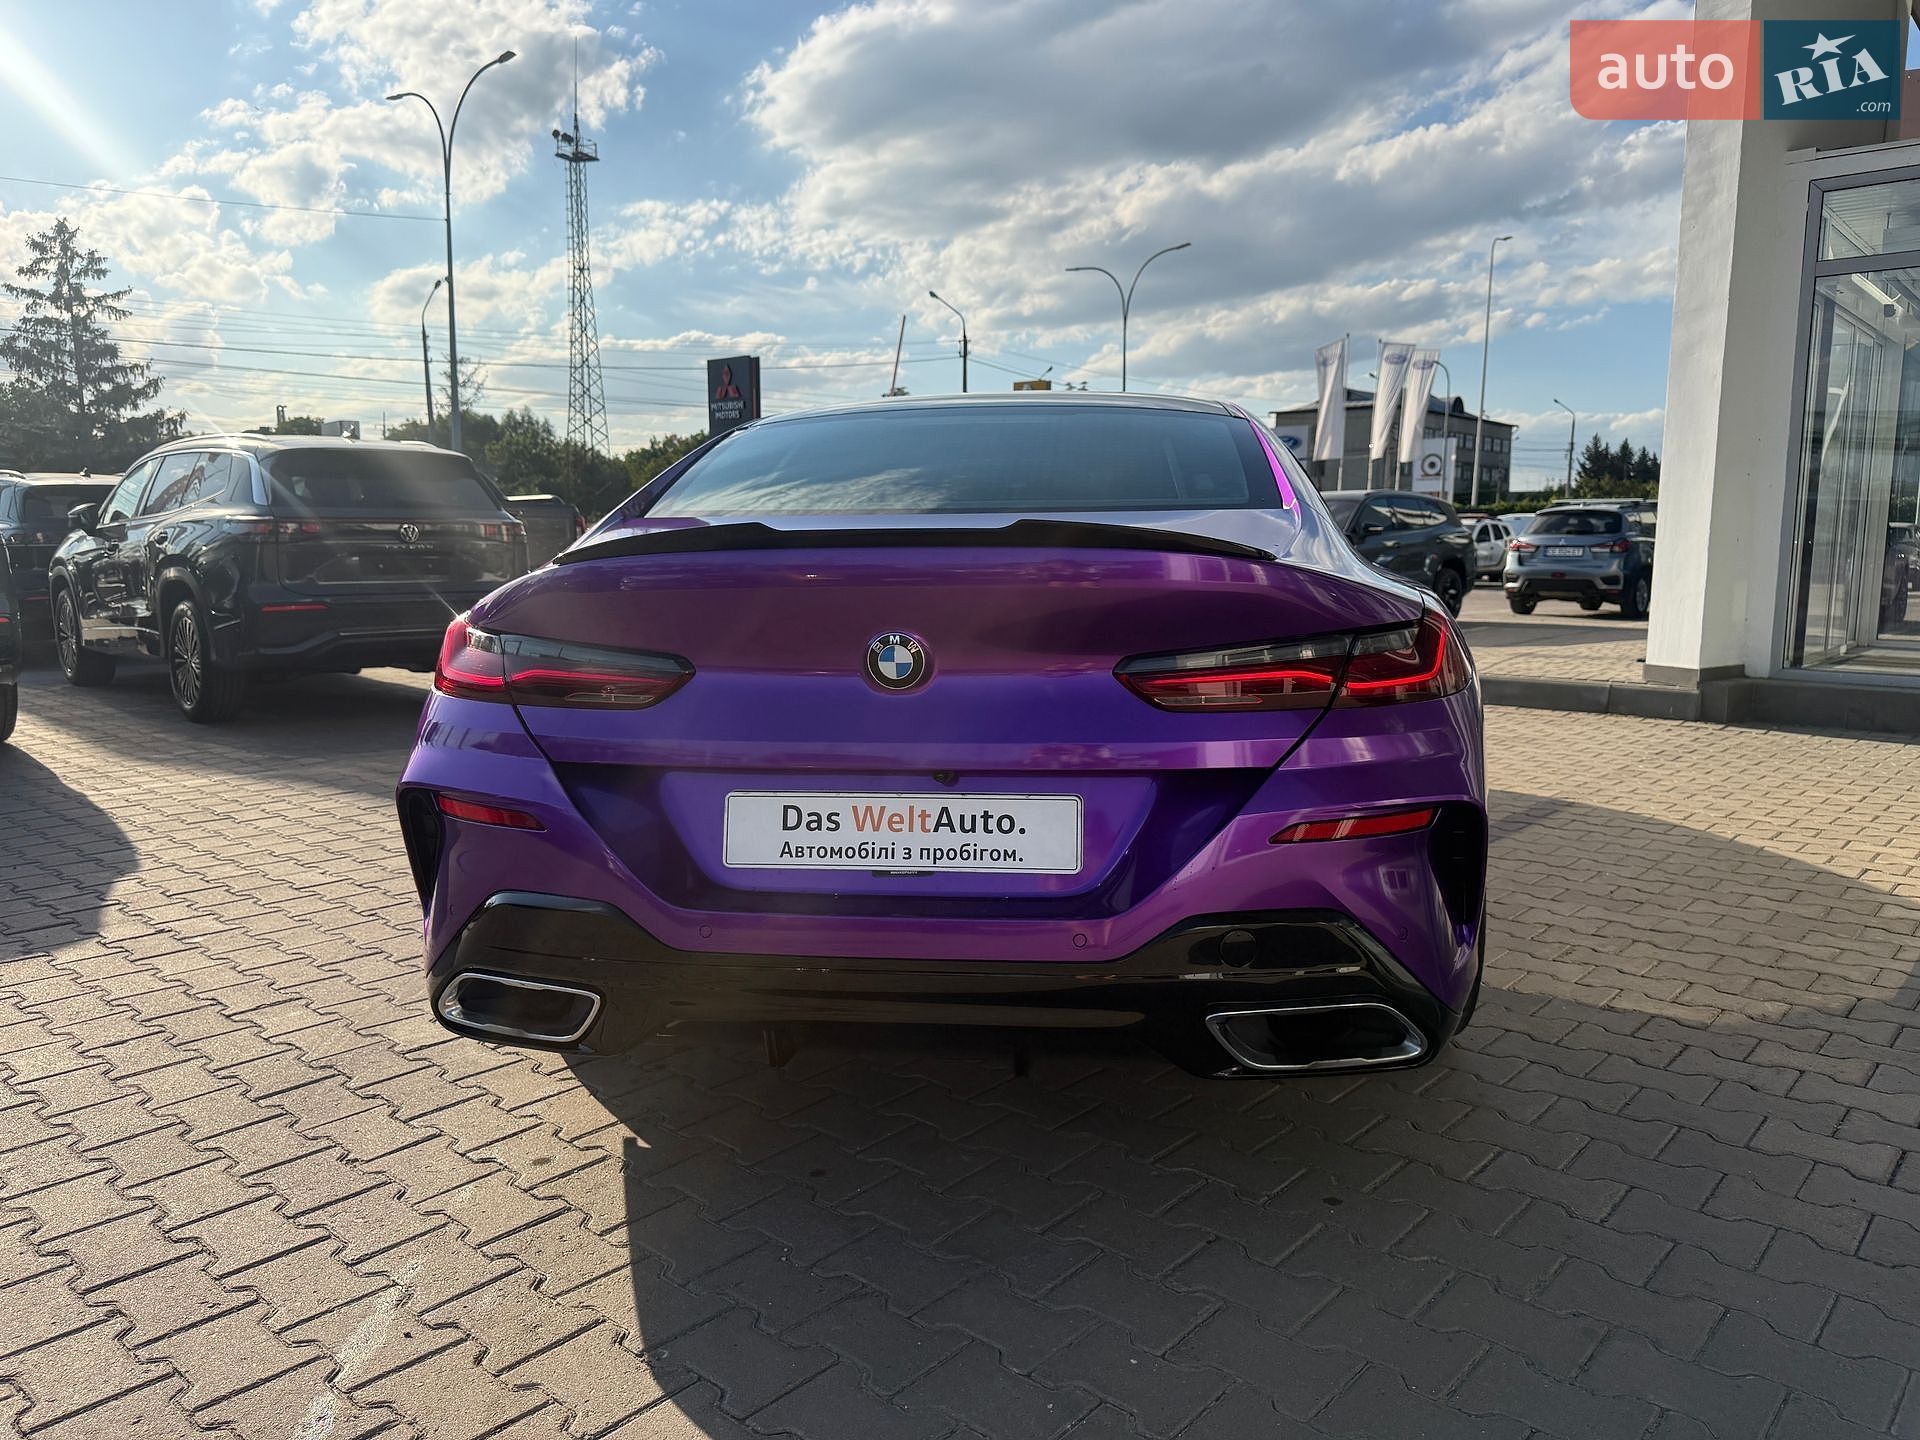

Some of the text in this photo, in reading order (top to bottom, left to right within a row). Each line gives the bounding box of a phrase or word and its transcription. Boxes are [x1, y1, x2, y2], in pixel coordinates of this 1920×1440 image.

[872, 635, 919, 653] BMW
[781, 804, 1027, 835] Das WeltAuto.
[779, 841, 1024, 865] Автомобілі з пробігом.
